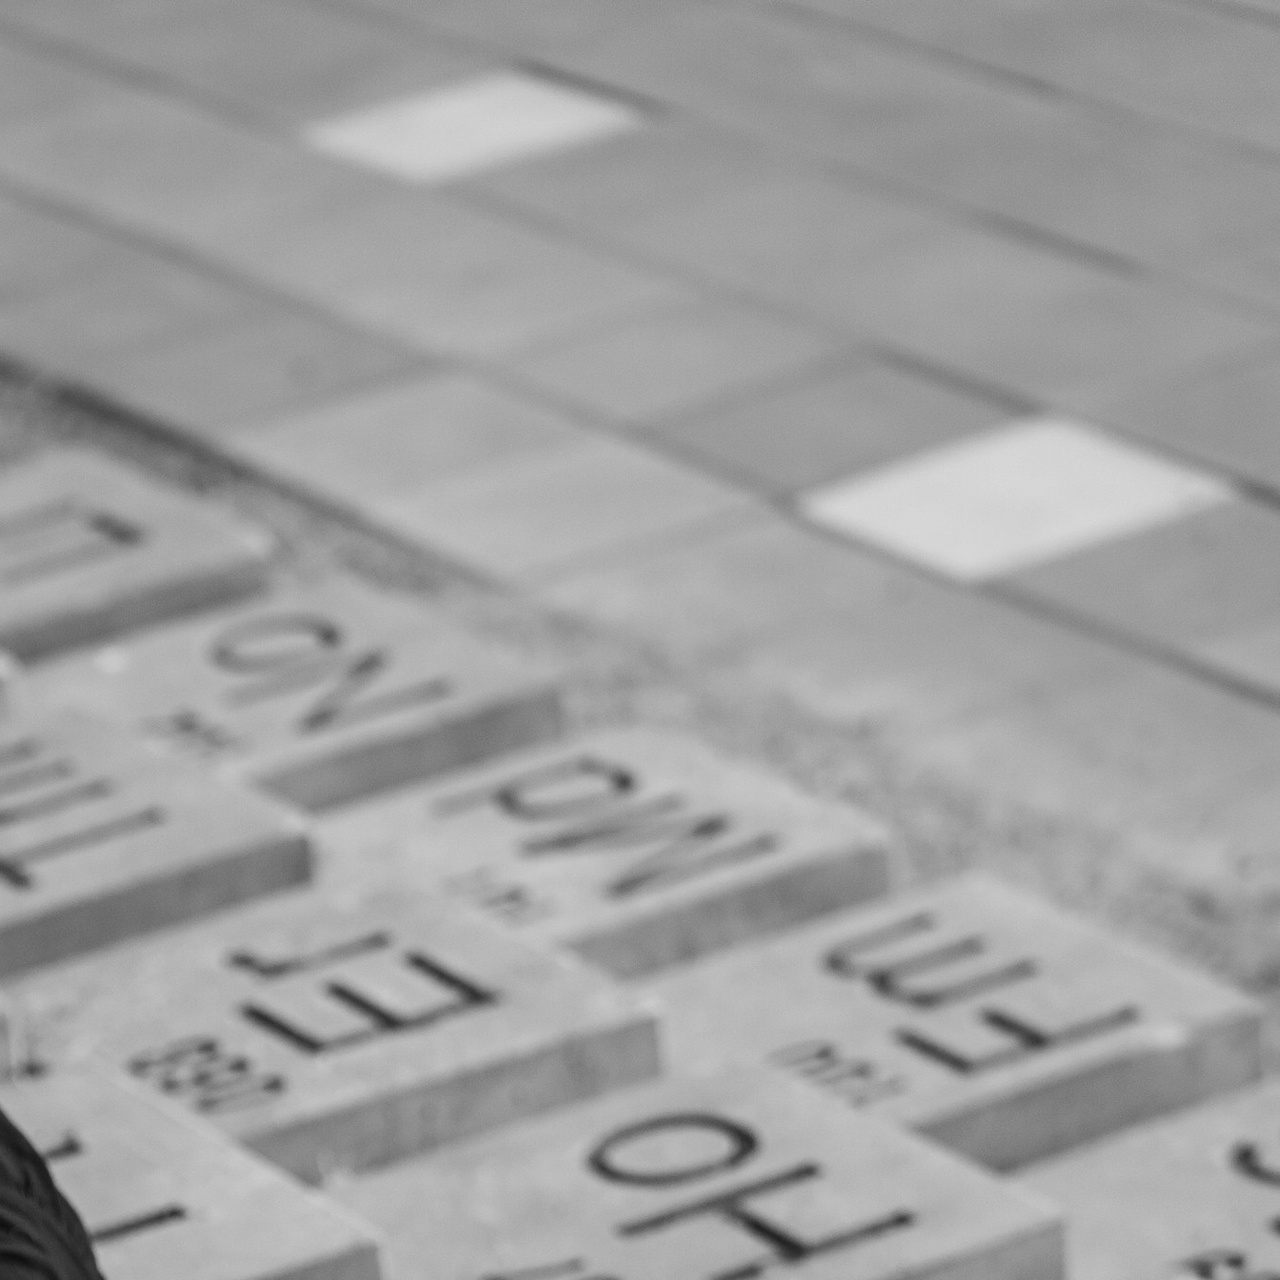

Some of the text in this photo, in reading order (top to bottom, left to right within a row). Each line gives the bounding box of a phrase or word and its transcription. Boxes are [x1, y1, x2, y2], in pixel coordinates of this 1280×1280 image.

[212, 611, 451, 733] No
[428, 754, 780, 896] Md
[229, 931, 499, 1054] Er
[822, 910, 1139, 1073] Fm
